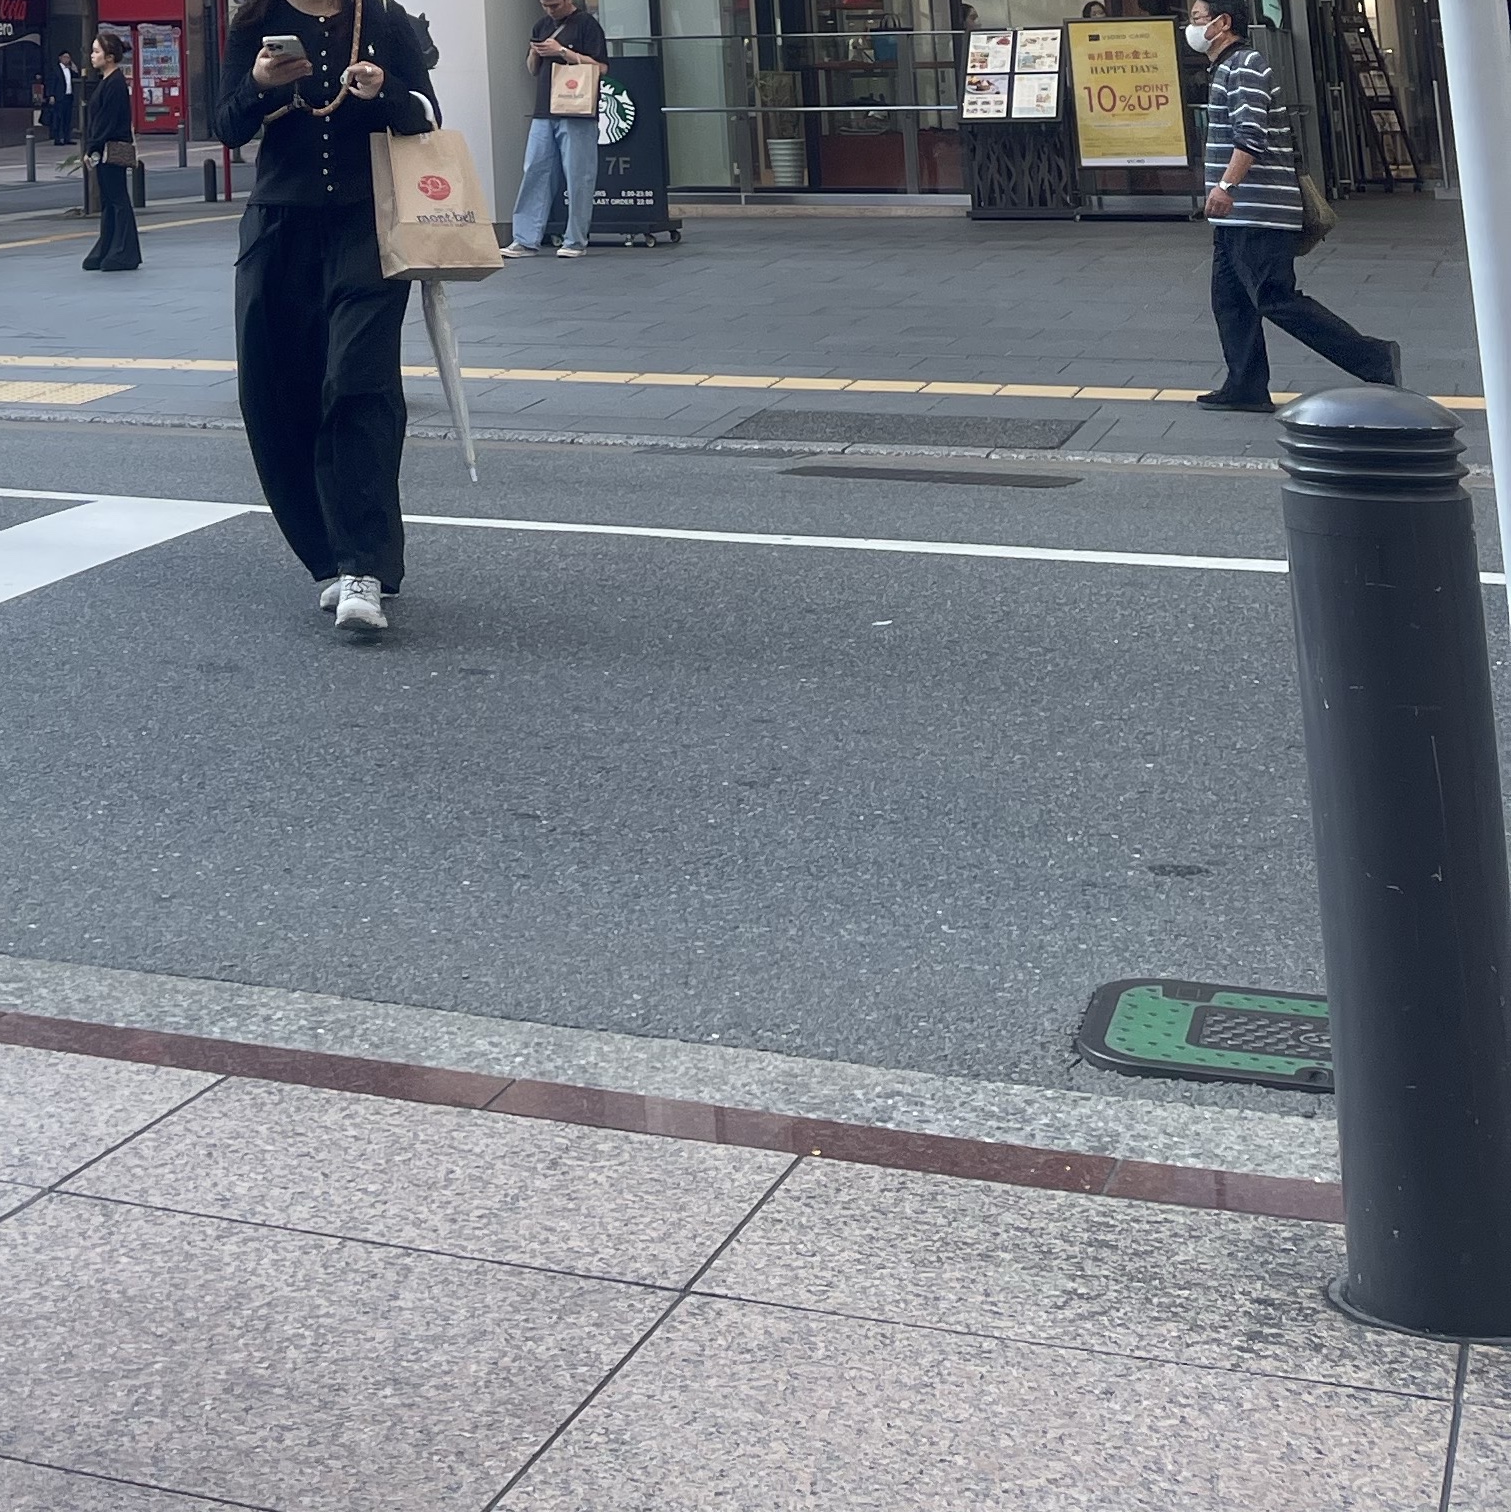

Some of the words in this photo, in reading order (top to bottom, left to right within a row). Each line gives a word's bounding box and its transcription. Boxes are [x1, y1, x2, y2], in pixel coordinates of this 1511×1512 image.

[1090, 66, 1127, 74] HAPPY
[1130, 65, 1159, 74] DAYS
[1134, 84, 1170, 93] POINT
[605, 157, 631, 175] 7F
